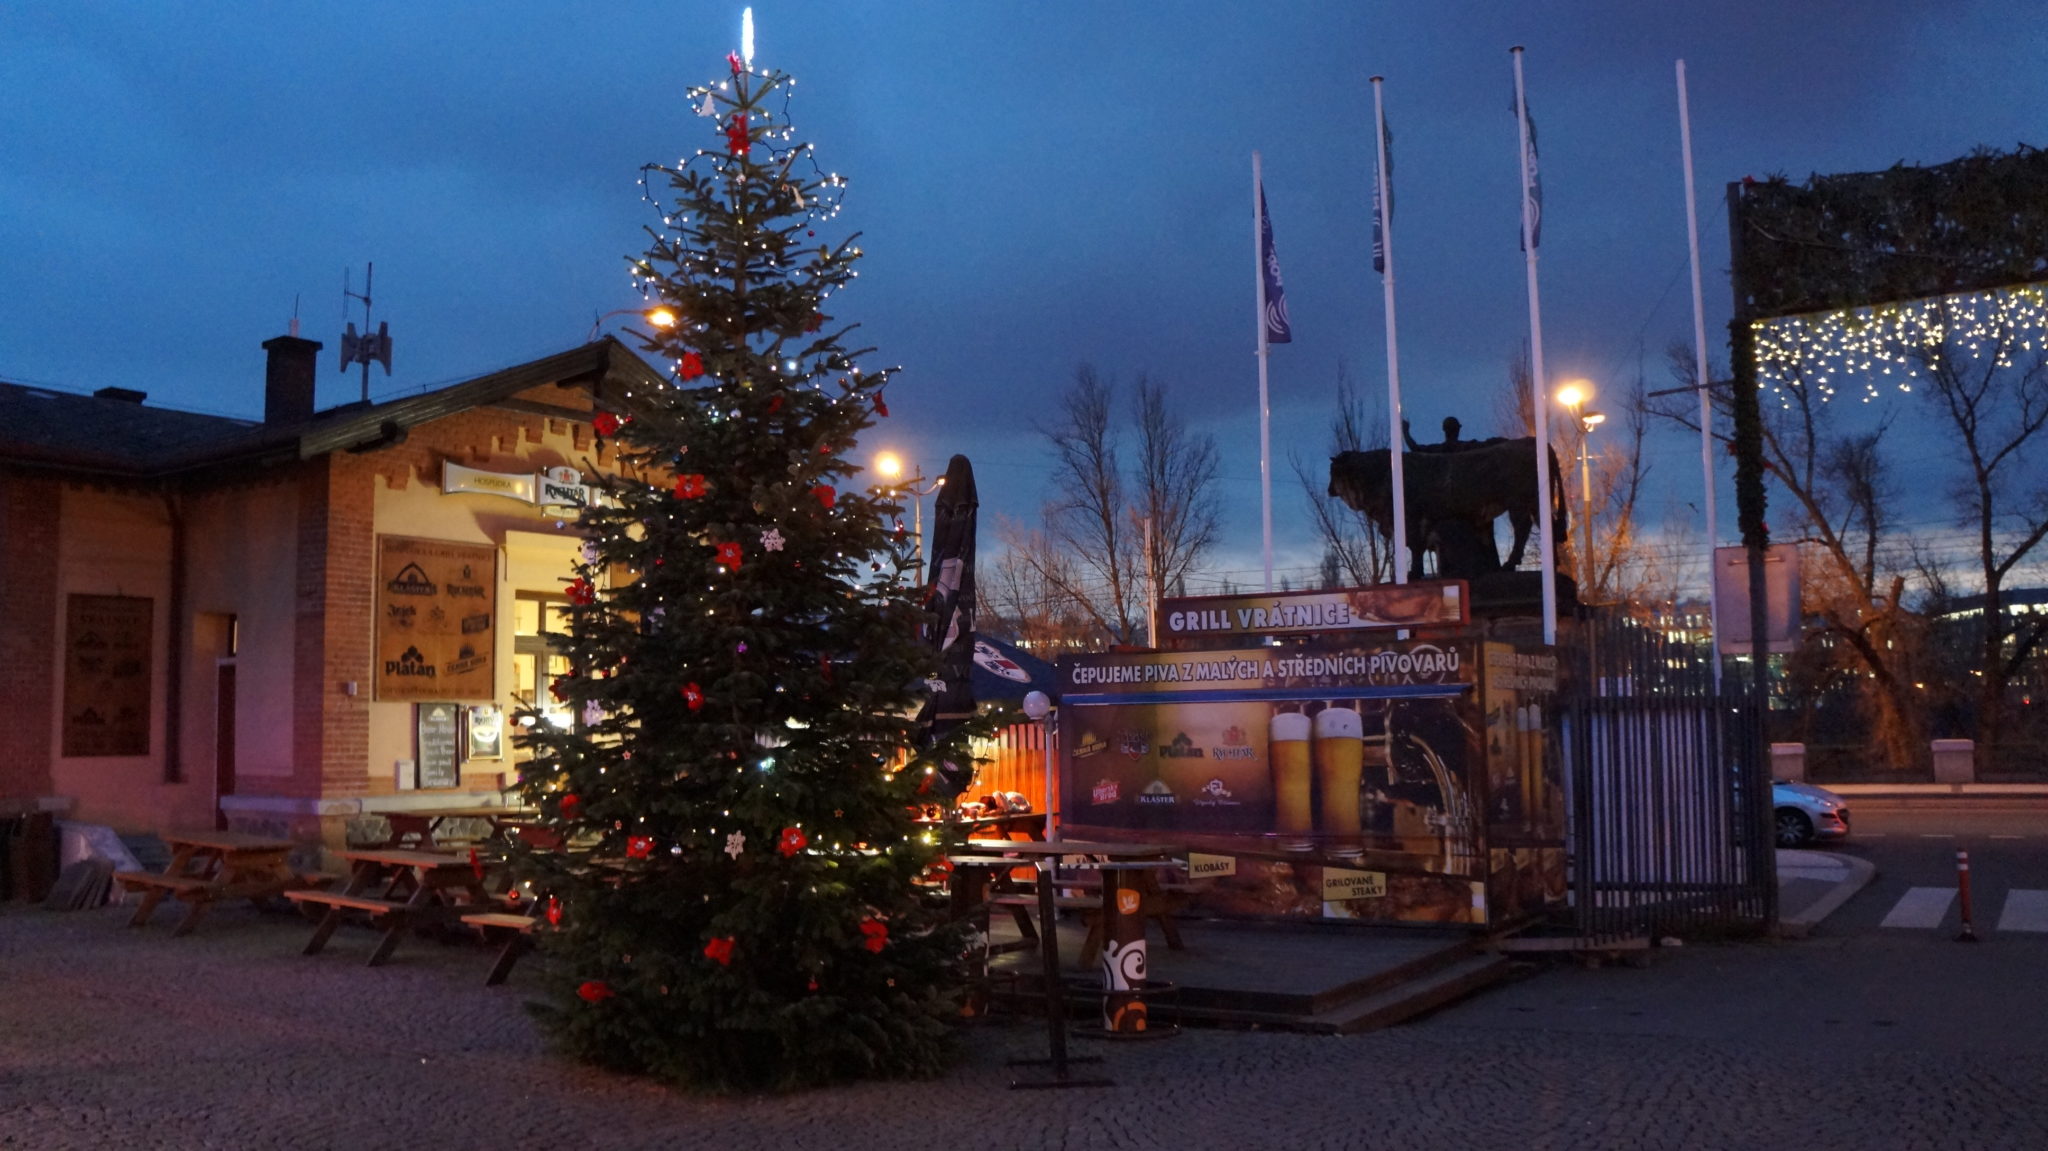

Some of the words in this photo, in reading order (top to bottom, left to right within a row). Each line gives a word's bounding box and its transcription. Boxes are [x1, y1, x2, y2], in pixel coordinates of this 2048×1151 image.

[1169, 608, 1232, 633] GRILL
[1241, 601, 1351, 629] VRÁTNICE
[385, 661, 436, 678] Platan
[1072, 662, 1142, 685] ČEPUJEME
[1145, 663, 1179, 683] PIVA
[1182, 663, 1194, 682] Z
[1196, 656, 1259, 681] MALÝCH
[1262, 659, 1275, 678] A
[1278, 652, 1367, 678] STŘEDNÍCH
[1370, 646, 1460, 675] PIVOVARŮ
[1325, 874, 1374, 888] GRILOVANÉ
[1351, 886, 1383, 897] STEAKY
